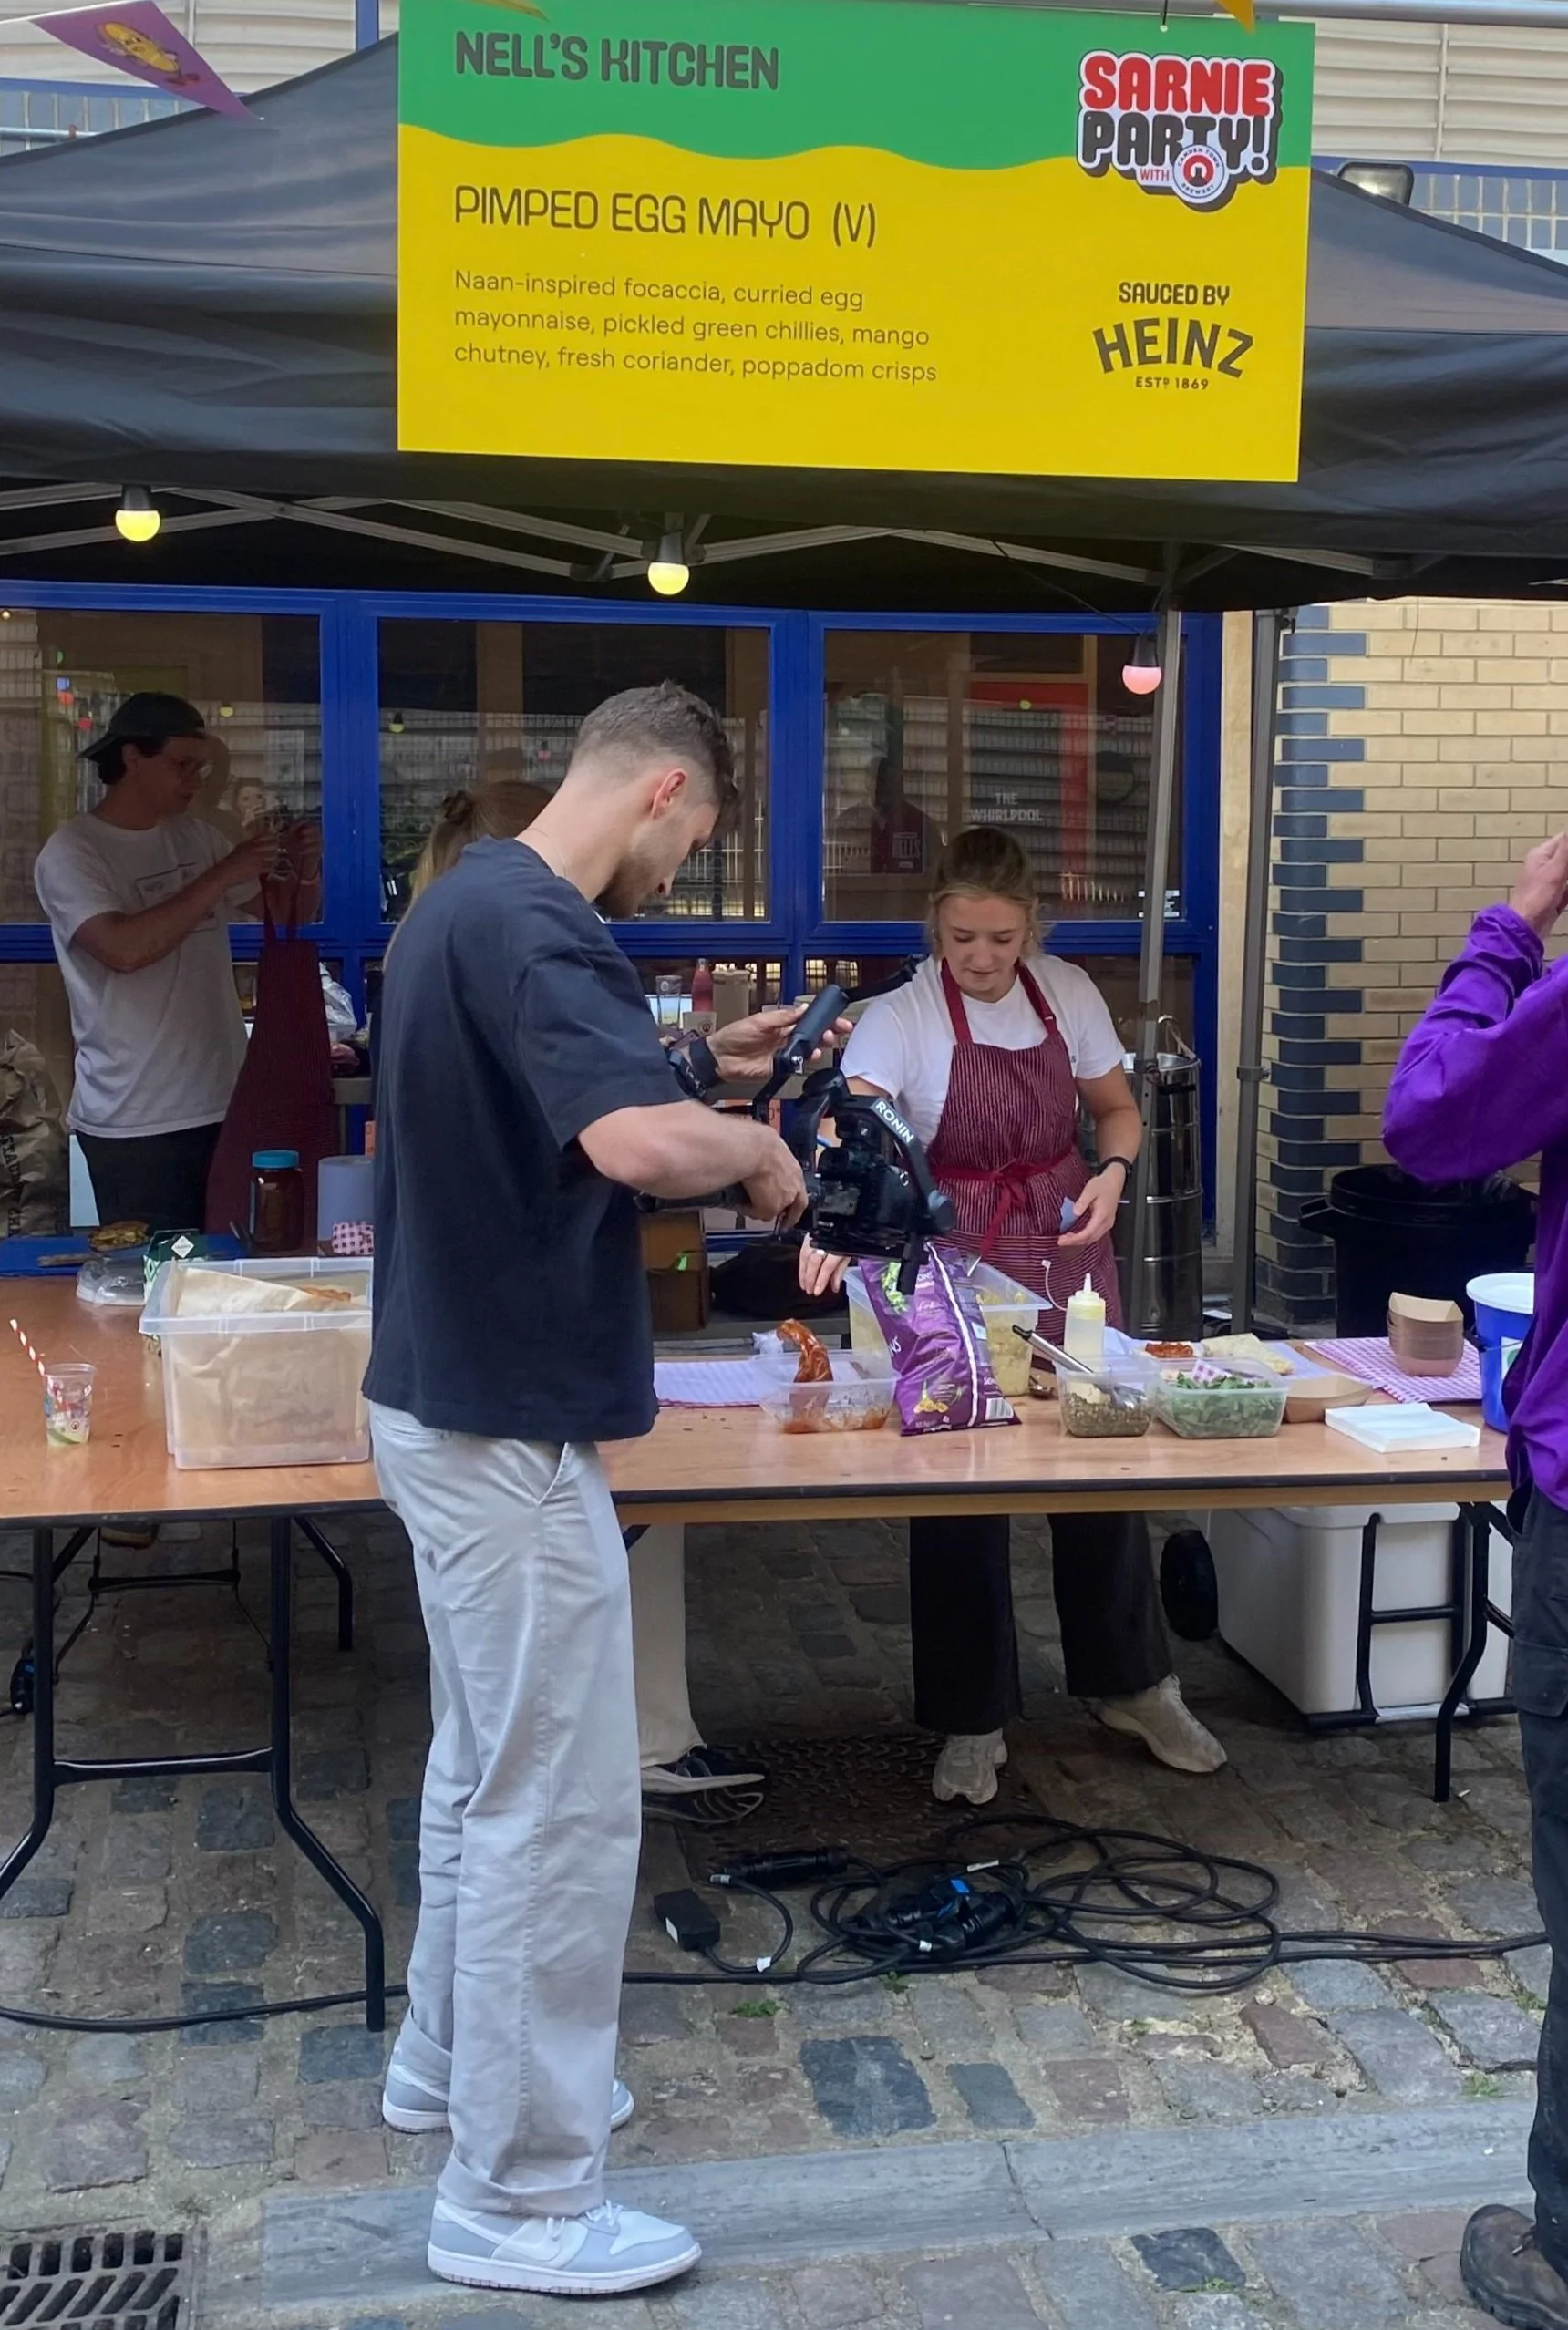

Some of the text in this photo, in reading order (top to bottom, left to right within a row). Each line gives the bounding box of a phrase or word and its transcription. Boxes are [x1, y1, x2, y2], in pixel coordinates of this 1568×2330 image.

[456, 31, 779, 90] NELL'S KITCHEN
[1084, 55, 1271, 116] SARNIE
[1082, 111, 1265, 171] PARTY!
[1178, 147, 1220, 169] CAMDEN TOWN
[1140, 168, 1170, 182] WITH
[1181, 182, 1215, 194] BREWERY
[455, 185, 876, 248] PIMPED EGG MAYO (V)
[455, 270, 863, 312] Naan-inspired focaccia, curried egg
[1119, 282, 1230, 306] SAUCED BY
[455, 310, 930, 350] mayonnaise, pickled green chillies, mango
[1092, 317, 1254, 379] HEINZ
[454, 343, 937, 385] chutney, fresh coriander, poppadom crisps
[1175, 377, 1210, 390] 1869
[972, 809, 1044, 822] WHIRLPOOL
[995, 791, 1018, 806] THE
[875, 1100, 914, 1144] RONIN
